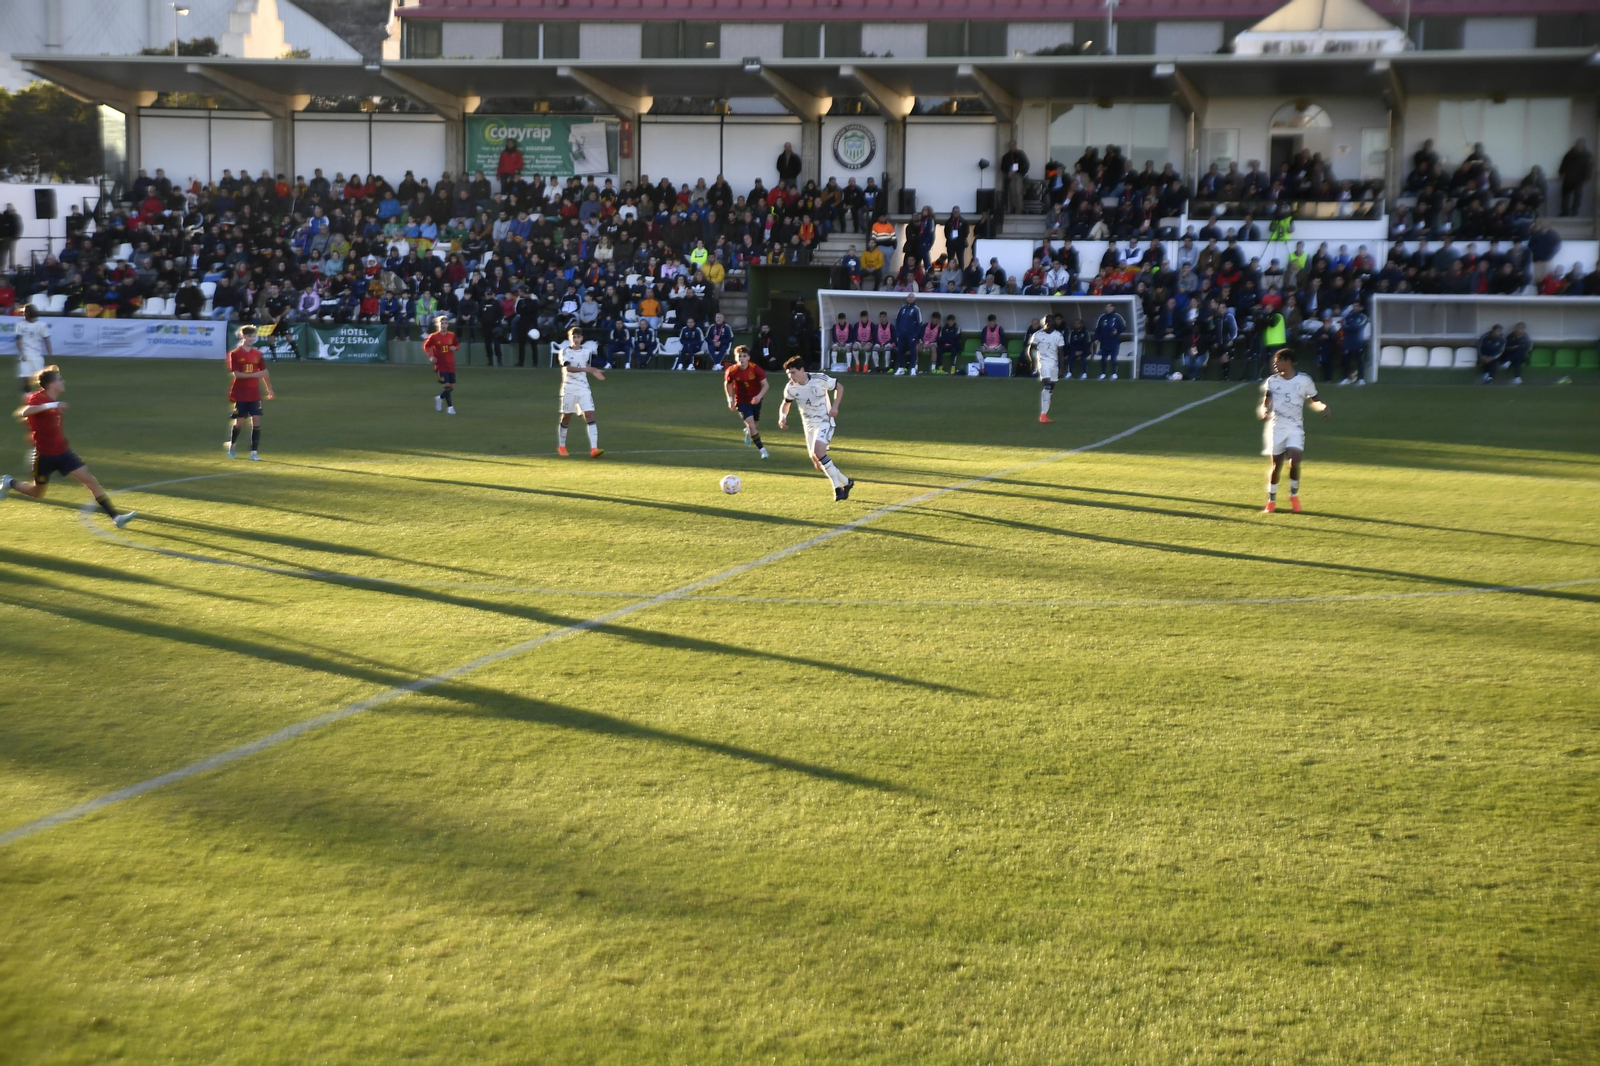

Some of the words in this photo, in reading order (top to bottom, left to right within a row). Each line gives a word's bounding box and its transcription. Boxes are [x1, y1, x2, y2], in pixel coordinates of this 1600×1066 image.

[490, 127, 552, 142] copyrap
[340, 328, 369, 336] HOTEL
[146, 338, 214, 346] TORREMOLINOS
[330, 336, 345, 344] PEZ
[347, 336, 380, 344] ESPADA
[442, 345, 449, 353] 11
[1047, 342, 1052, 350] 2
[245, 363, 254, 373] 10
[1285, 392, 1292, 403] 5
[805, 398, 812, 407] 4
